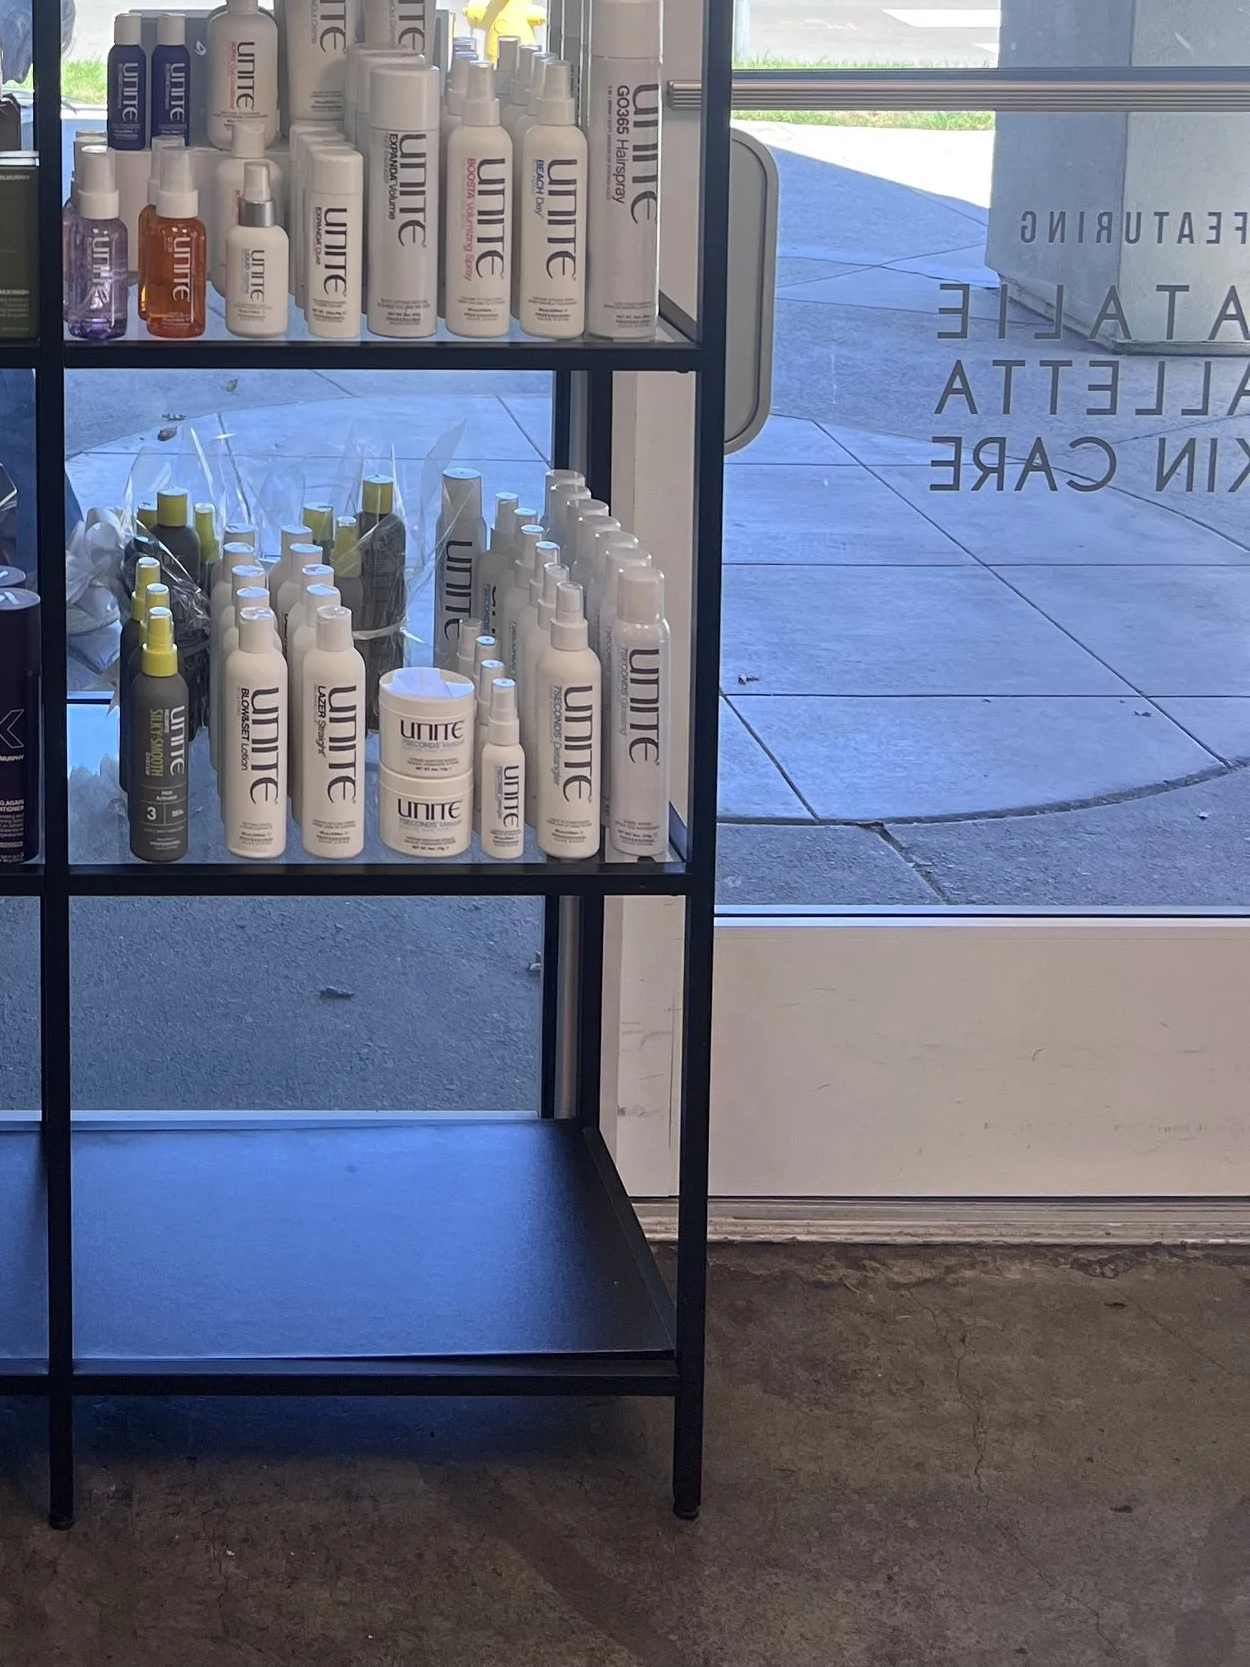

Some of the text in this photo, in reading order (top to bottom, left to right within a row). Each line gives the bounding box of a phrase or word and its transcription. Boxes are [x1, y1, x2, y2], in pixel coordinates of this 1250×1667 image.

[122, 62, 139, 123] UNITE
[169, 62, 186, 123] UNITE
[236, 42, 255, 110] UNITE
[388, 133, 398, 220] EXPANDA Volume
[613, 85, 629, 204] GO365 Hairspray
[398, 133, 426, 247] UNITE
[464, 158, 476, 281] BOOSTA Volumizing Spray
[475, 158, 505, 279] UNITE
[535, 159, 544, 216] BEACH Day
[546, 159, 577, 279] UNITE
[314, 207, 322, 246] EXPANDA
[323, 208, 347, 295] UNITE
[172, 237, 191, 302] UNITE
[250, 250, 265, 302] UNITE
[620, 646, 629, 697] 7SECONDS
[629, 648, 660, 765] UNITE
[169, 705, 185, 776] UNITE
[241, 688, 250, 770] BLOW&SET Lotion
[250, 688, 279, 805] UNITE
[316, 685, 326, 758] LAZER Straight
[327, 685, 357, 803] UNITE
[401, 719, 465, 741] UNITE
[553, 685, 562, 739] 7SECONDS
[562, 685, 593, 803] UNITE
[147, 807, 157, 820] 3
[398, 798, 463, 820] UNITE
[503, 765, 519, 827] UNITE
